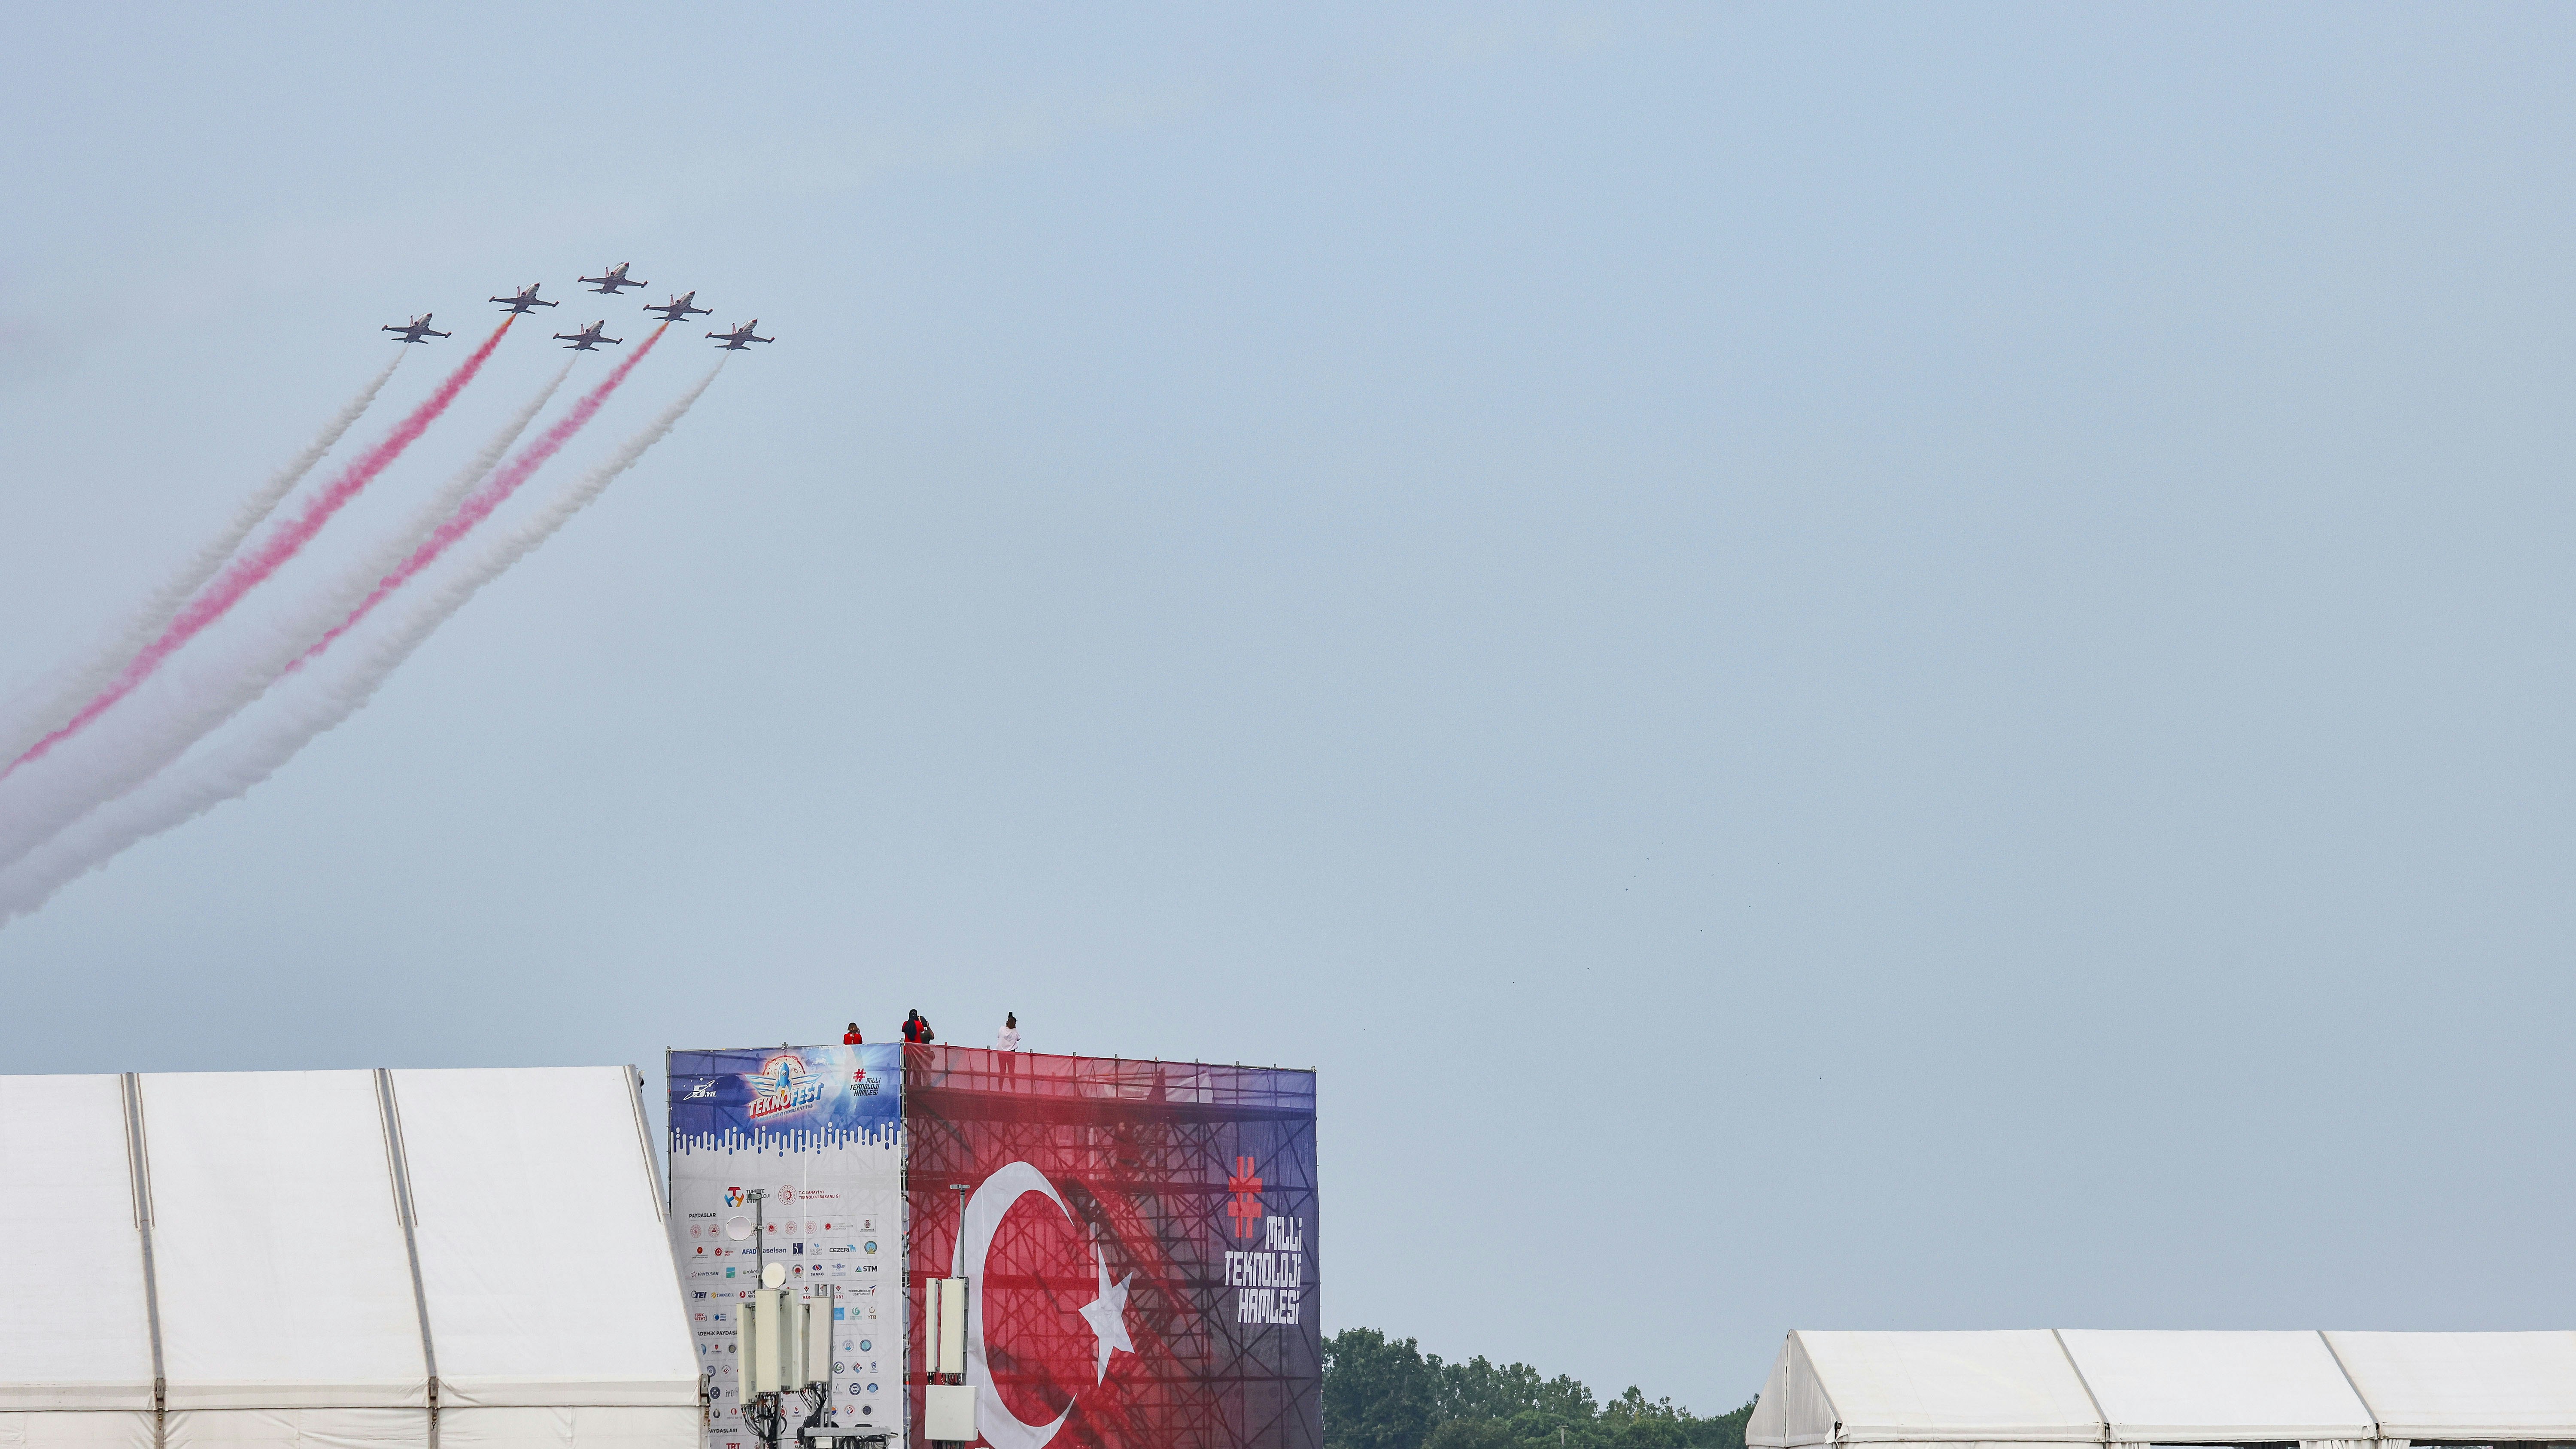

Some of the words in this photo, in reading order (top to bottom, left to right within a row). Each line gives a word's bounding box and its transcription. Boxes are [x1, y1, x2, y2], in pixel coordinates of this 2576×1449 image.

[748, 1082, 823, 1118] TEKNOFEST
[1225, 1251, 1302, 1288] TEKNOLOJİ
[1237, 1288, 1300, 1324] HAMLESİ
